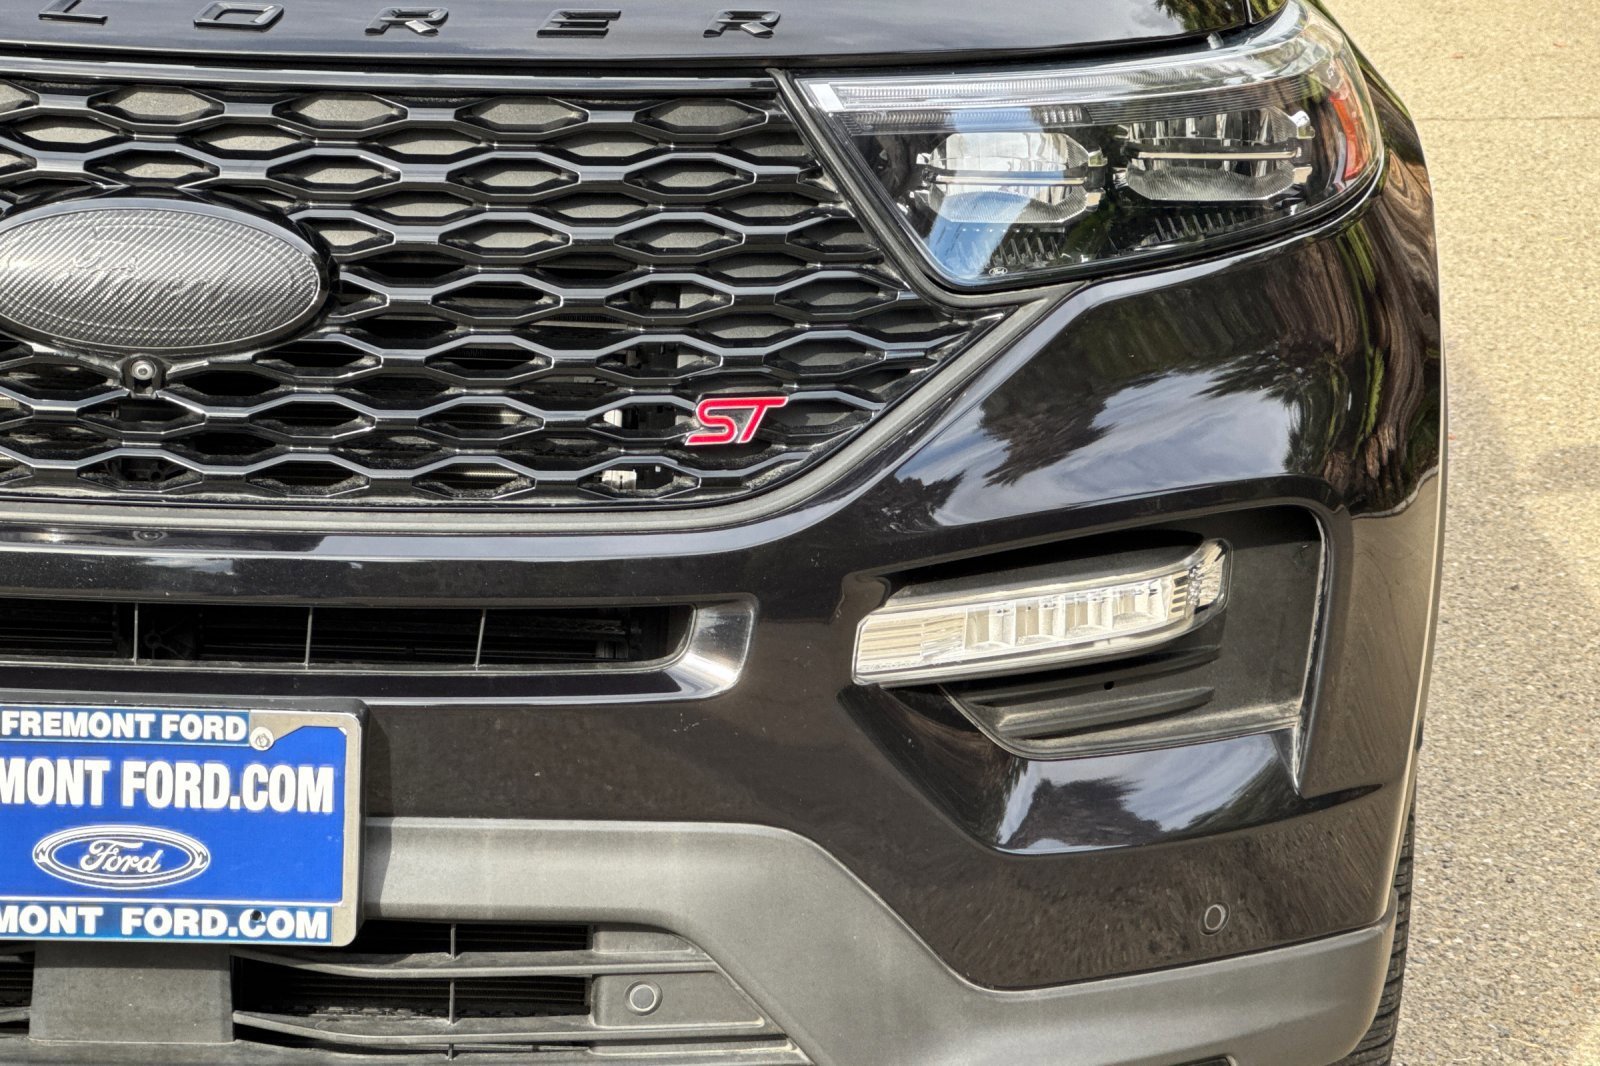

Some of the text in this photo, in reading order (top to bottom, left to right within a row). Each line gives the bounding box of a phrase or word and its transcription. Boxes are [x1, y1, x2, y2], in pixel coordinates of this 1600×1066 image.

[684, 396, 789, 446] ST
[1, 710, 247, 741] FREMONT FORD
[0, 757, 335, 813] MONT FORD.COM
[80, 839, 164, 873] Ford
[0, 904, 328, 939] MONT FORD.COM
